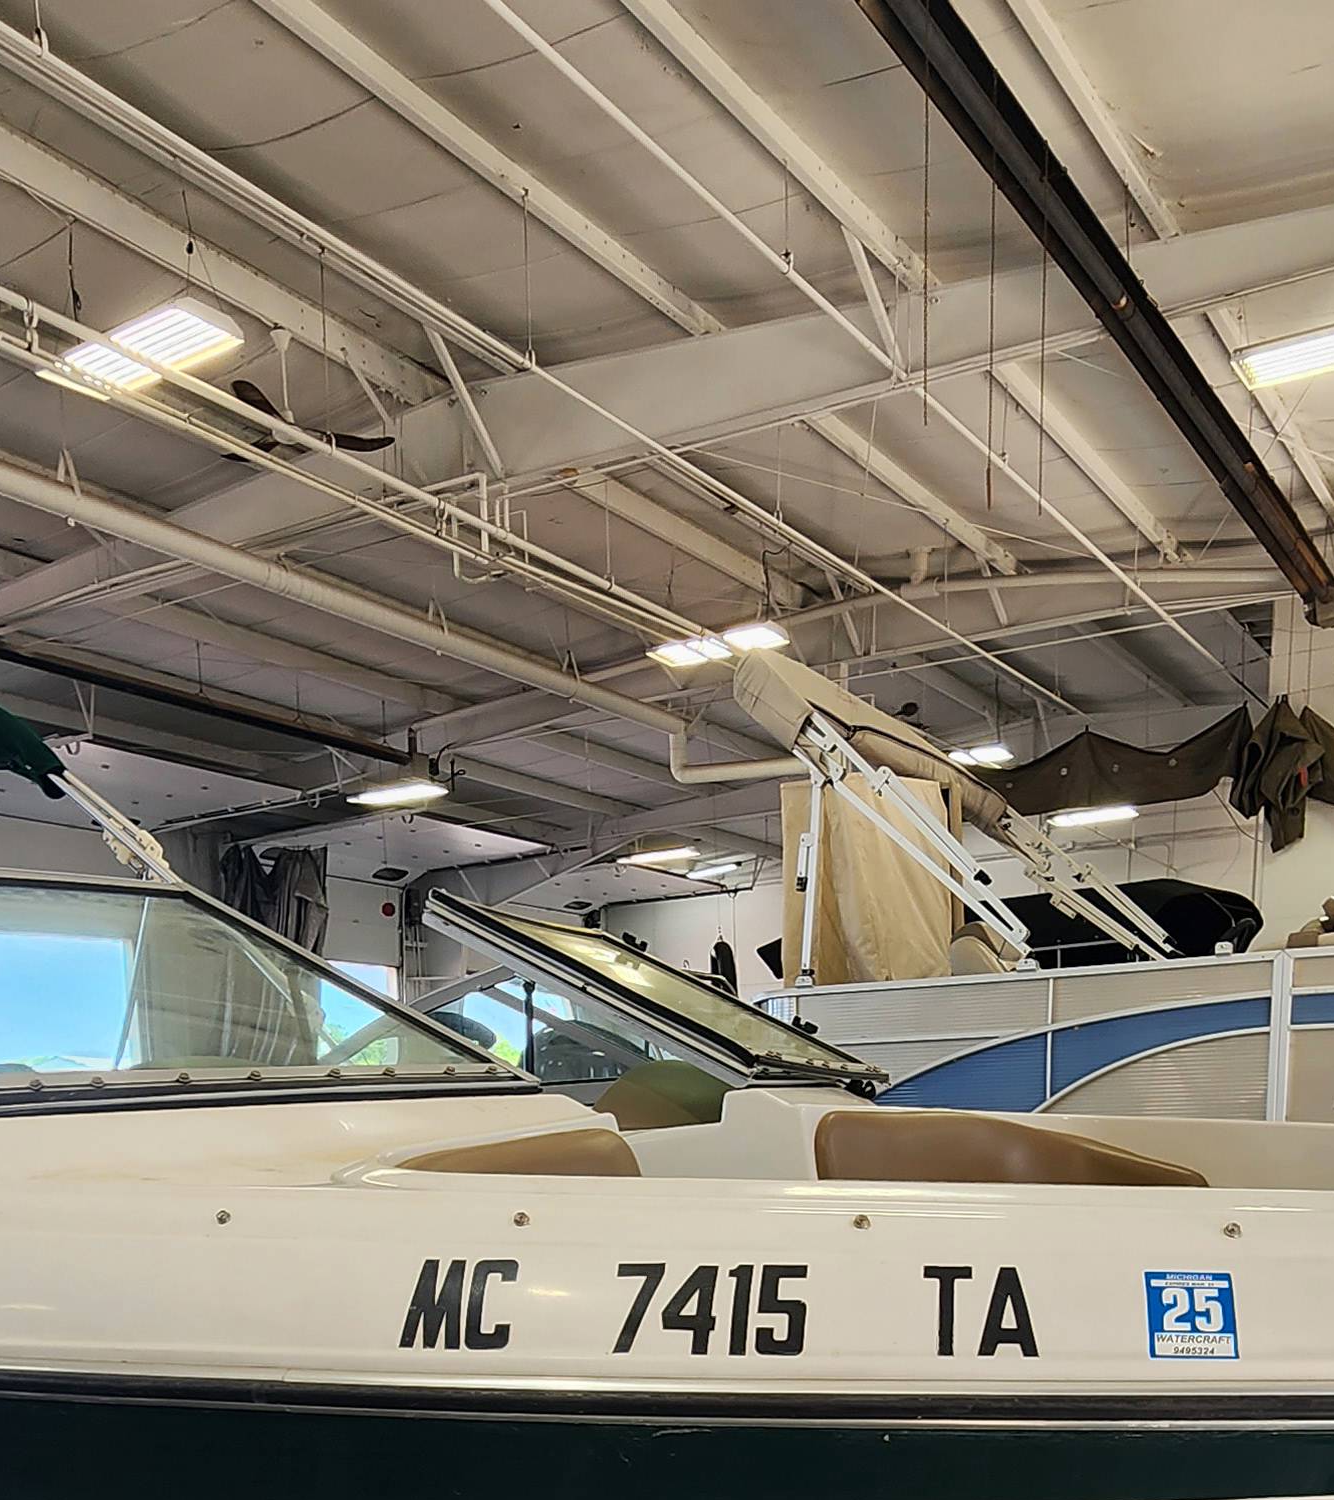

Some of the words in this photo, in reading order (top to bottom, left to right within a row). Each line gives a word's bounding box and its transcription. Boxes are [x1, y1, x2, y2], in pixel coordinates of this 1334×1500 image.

[1166, 1273, 1213, 1281] MICHIGAN
[398, 1259, 520, 1350] MC
[612, 1264, 809, 1356] 7415
[923, 1265, 1040, 1357] TA
[1162, 1288, 1224, 1332] 25
[1156, 1334, 1232, 1345] WATERCRAFT
[1173, 1346, 1215, 1355] 9495324
